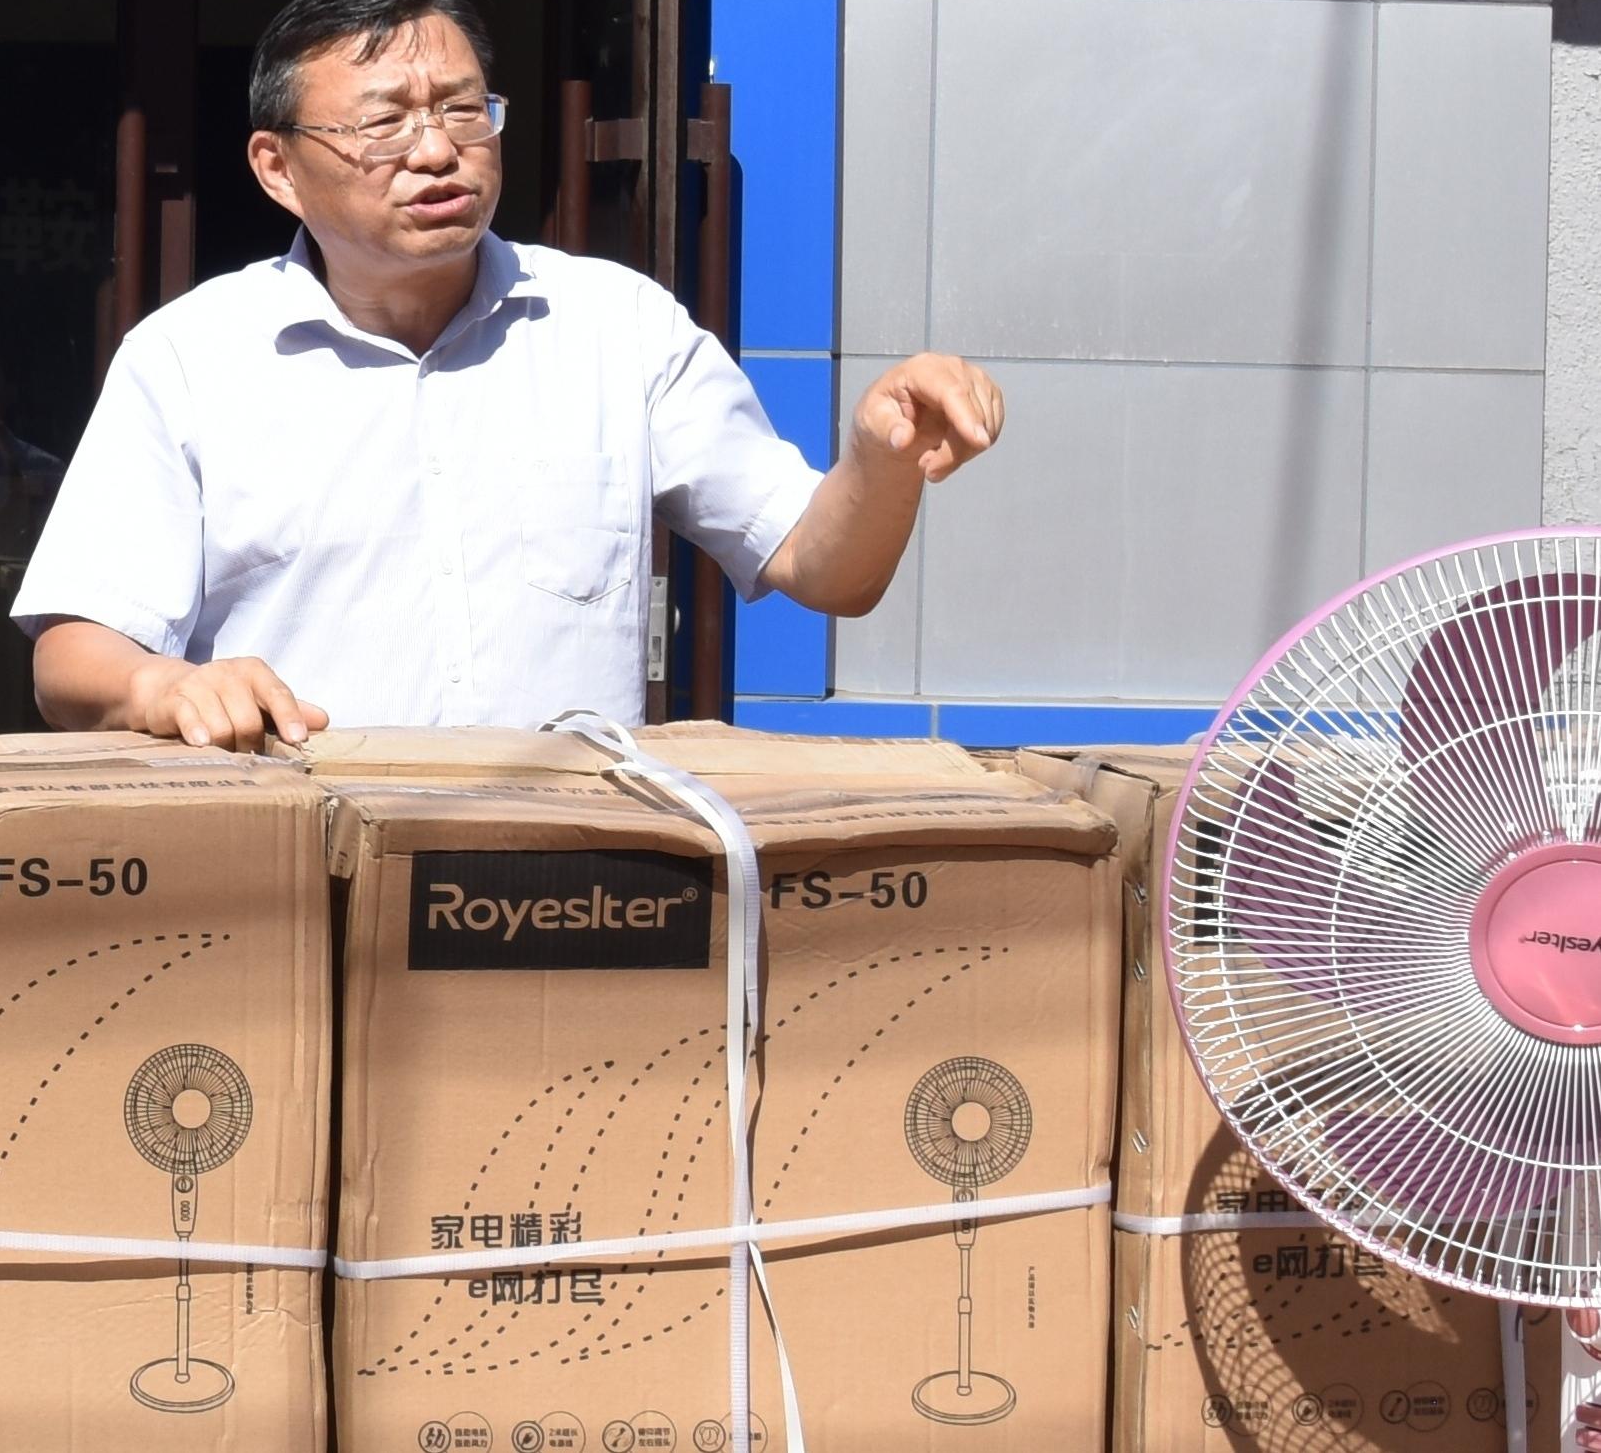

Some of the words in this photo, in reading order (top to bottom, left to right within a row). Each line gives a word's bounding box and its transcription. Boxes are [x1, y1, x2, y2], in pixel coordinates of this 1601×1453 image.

[769, 870, 929, 910] FS-50
[431, 1211, 582, 1249] 家电精彩
[467, 1267, 606, 1306] e网打尽
